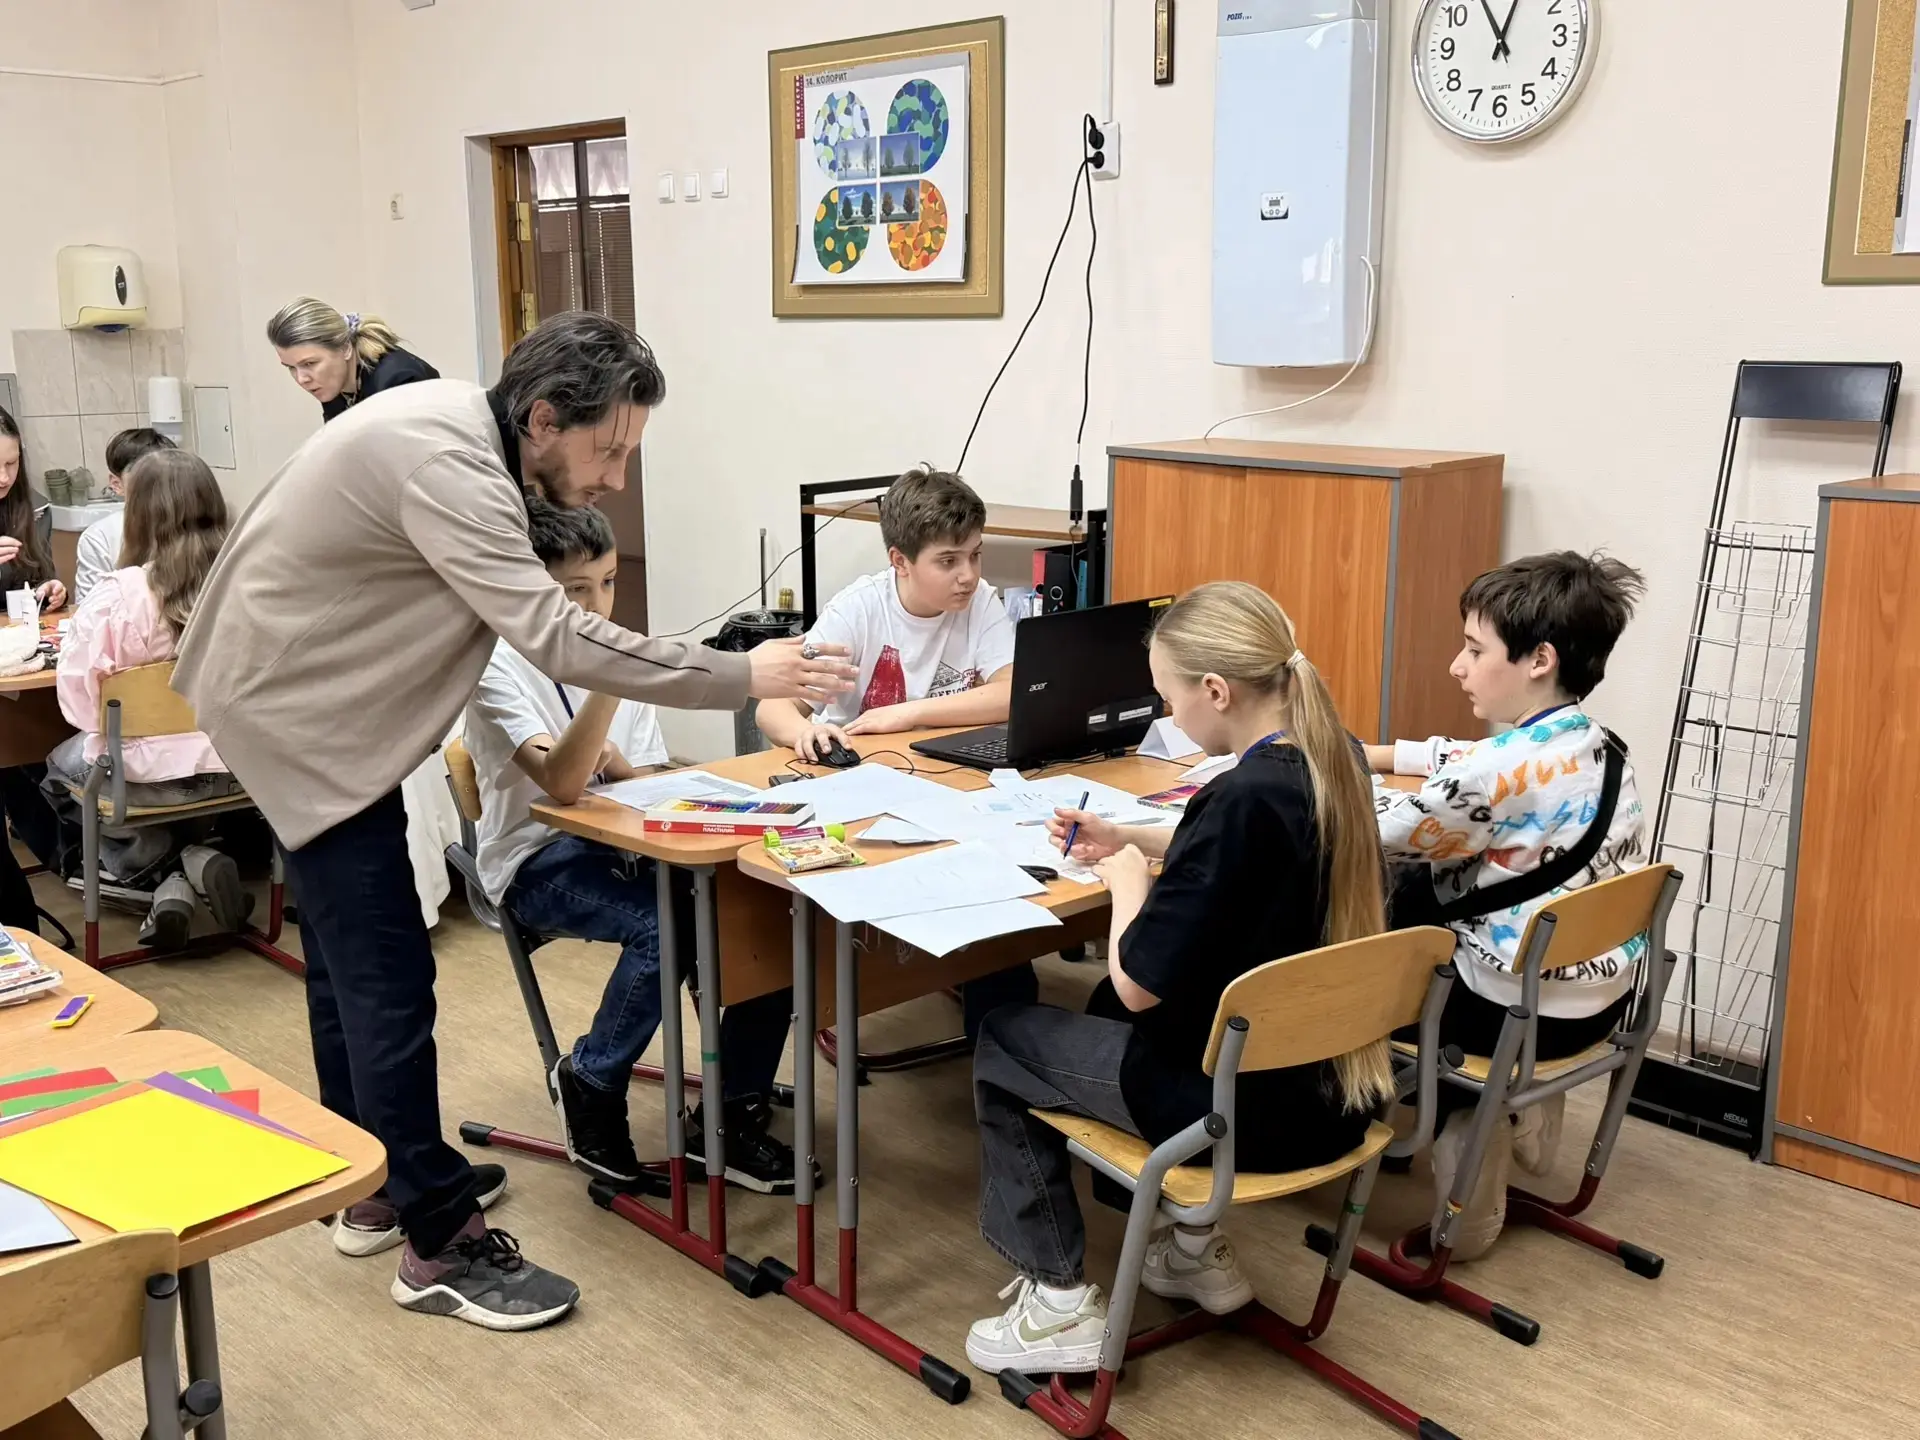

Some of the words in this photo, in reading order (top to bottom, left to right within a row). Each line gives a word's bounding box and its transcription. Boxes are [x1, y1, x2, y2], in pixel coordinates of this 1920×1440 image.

[1444, 4, 1468, 28] 10
[1552, 23, 1568, 48] 3
[1440, 37, 1455, 60] 9
[816, 72, 848, 85] КОЛОРИТ
[1446, 68, 1462, 92] 8
[1541, 57, 1558, 80] 4
[1468, 88, 1483, 112] 7
[1521, 83, 1536, 106] 5
[1492, 95, 1508, 118] 6
[1028, 682, 1048, 692] acer
